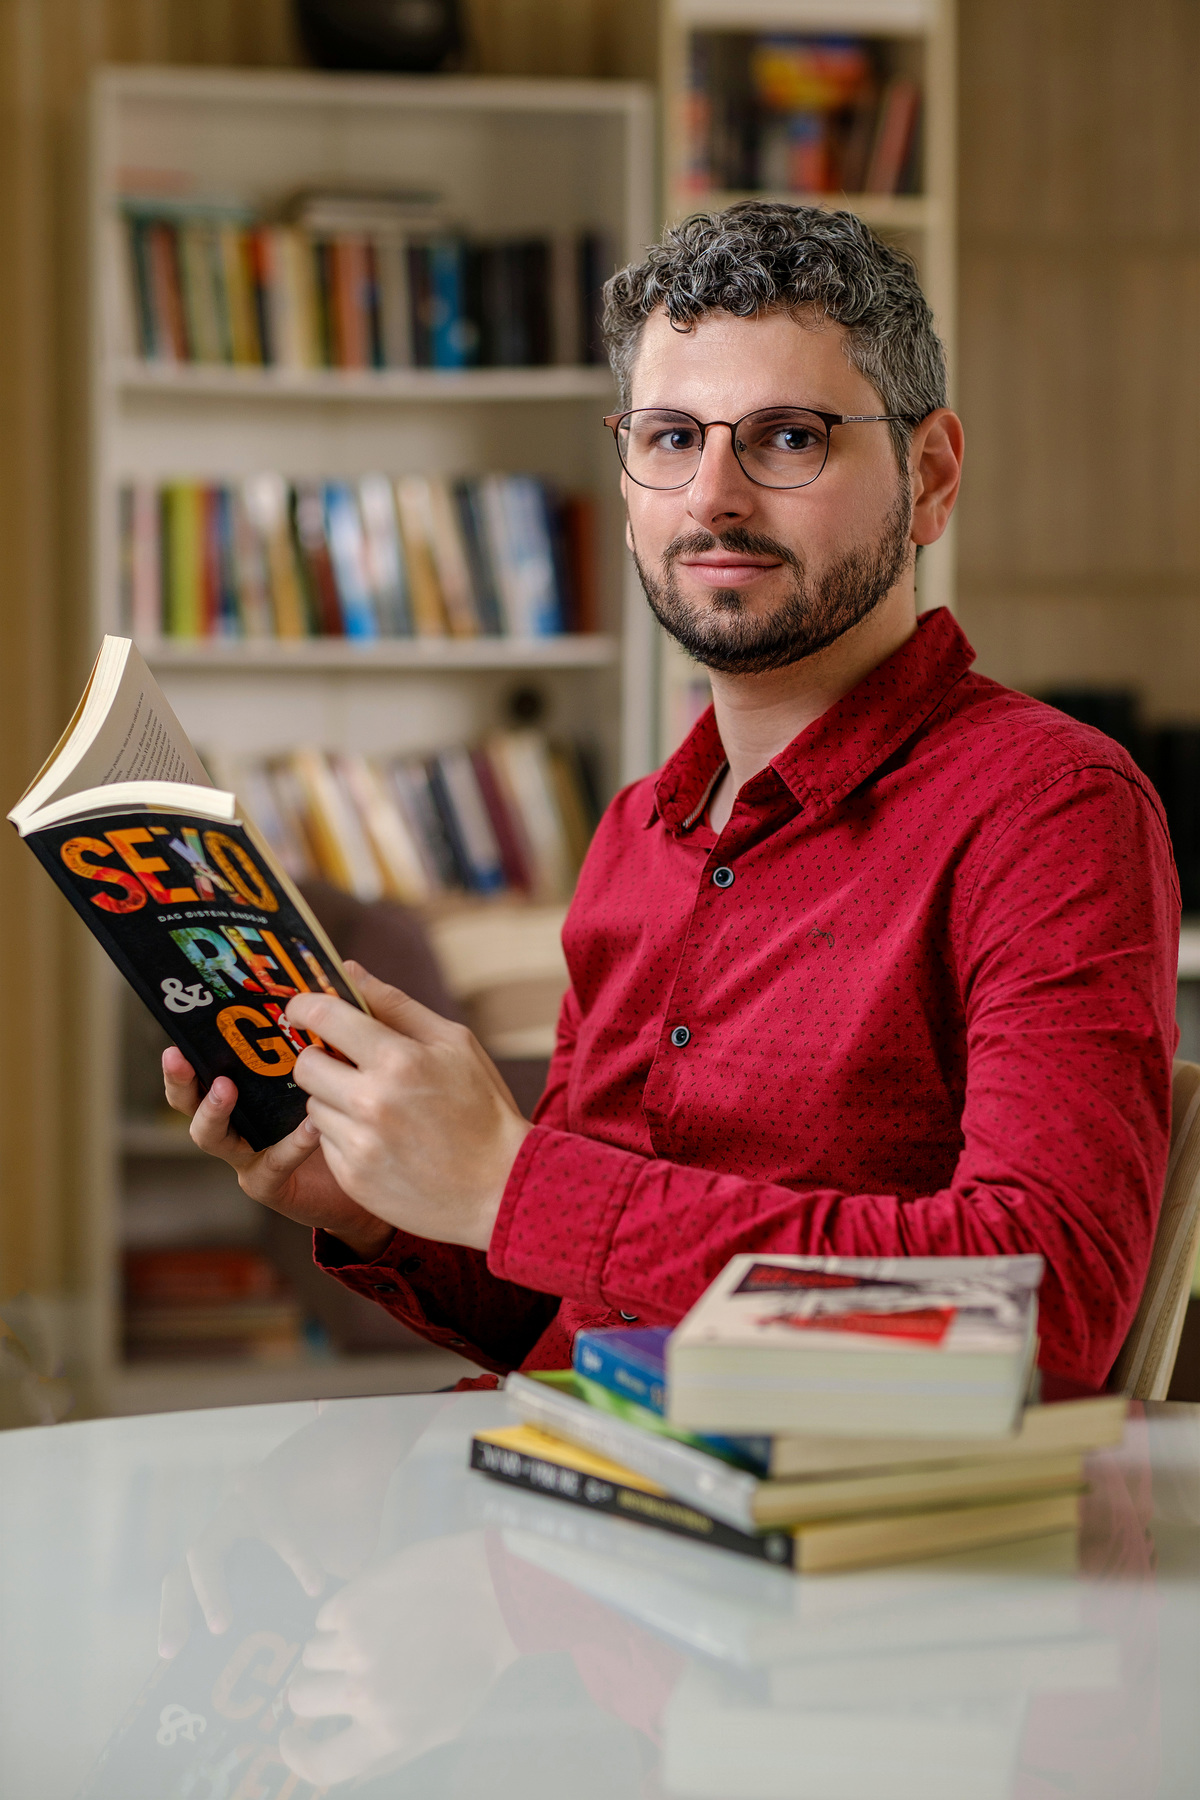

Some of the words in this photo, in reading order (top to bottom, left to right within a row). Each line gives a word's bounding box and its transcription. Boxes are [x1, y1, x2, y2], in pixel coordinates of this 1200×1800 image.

[60, 826, 280, 914] SEXO
[157, 912, 183, 923] DAG
[160, 977, 214, 1014] &
